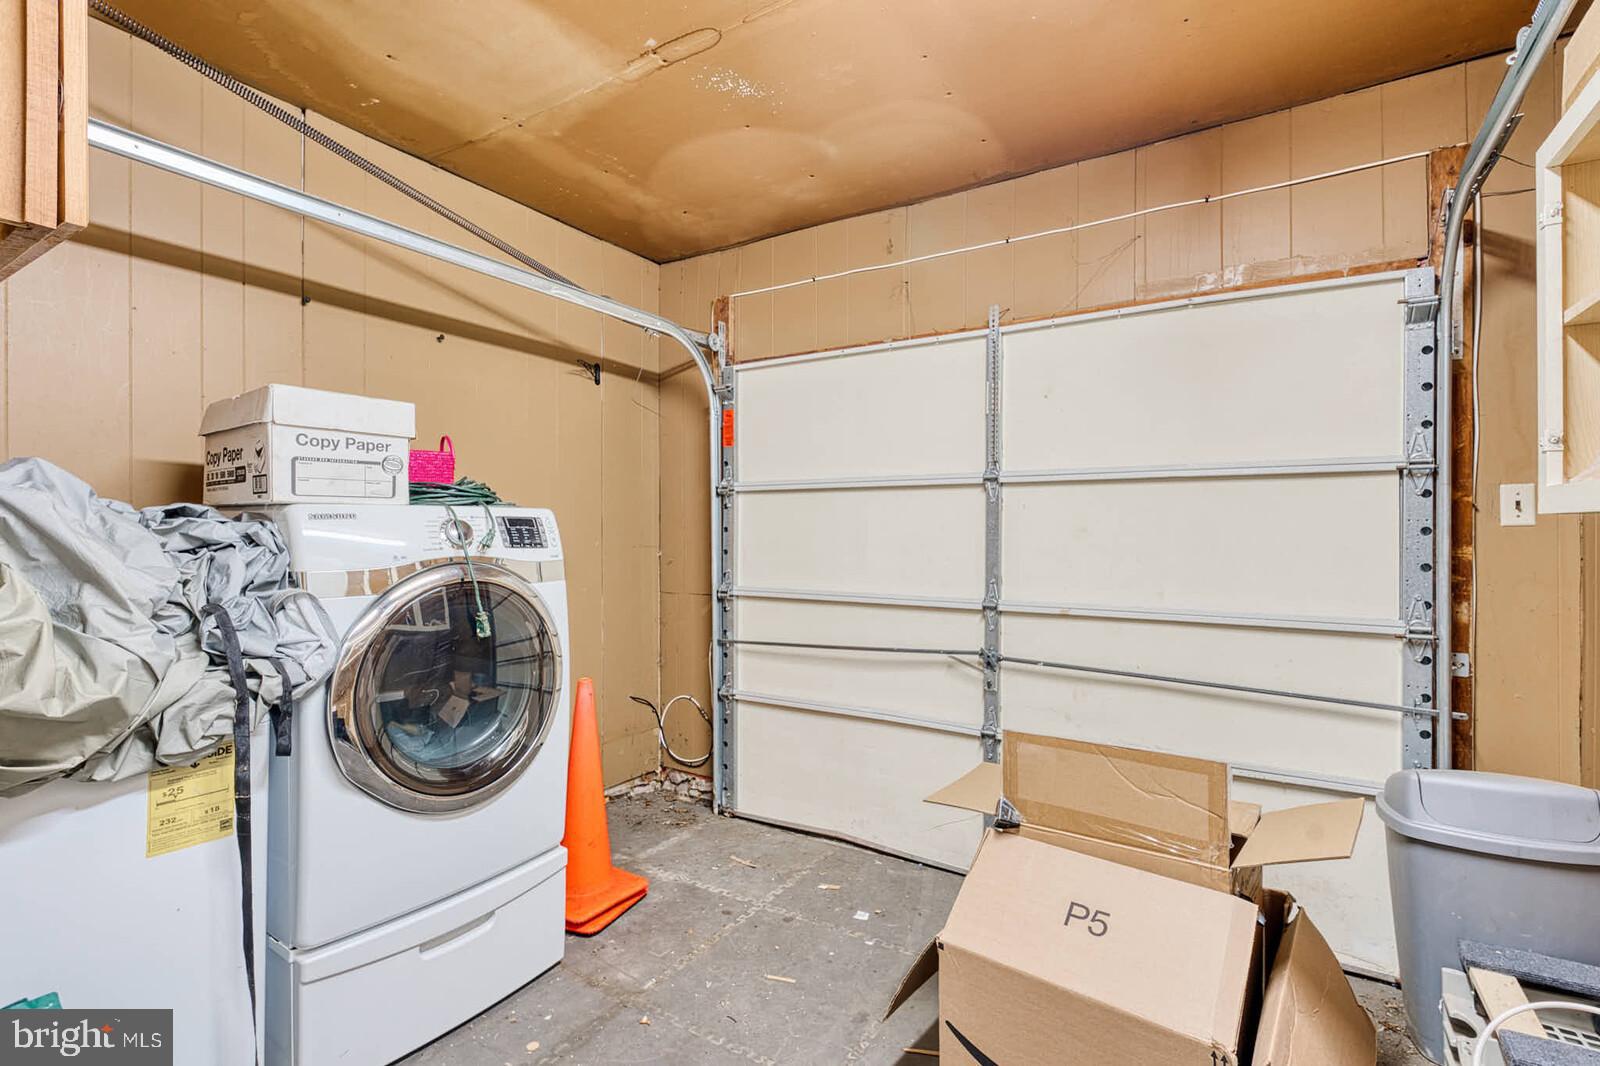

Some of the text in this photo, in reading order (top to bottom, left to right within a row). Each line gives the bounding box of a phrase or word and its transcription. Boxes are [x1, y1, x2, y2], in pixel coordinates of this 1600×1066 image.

[296, 433, 391, 454] Copy Paper
[206, 447, 243, 468] Copy Paper
[1063, 901, 1111, 938] P5
